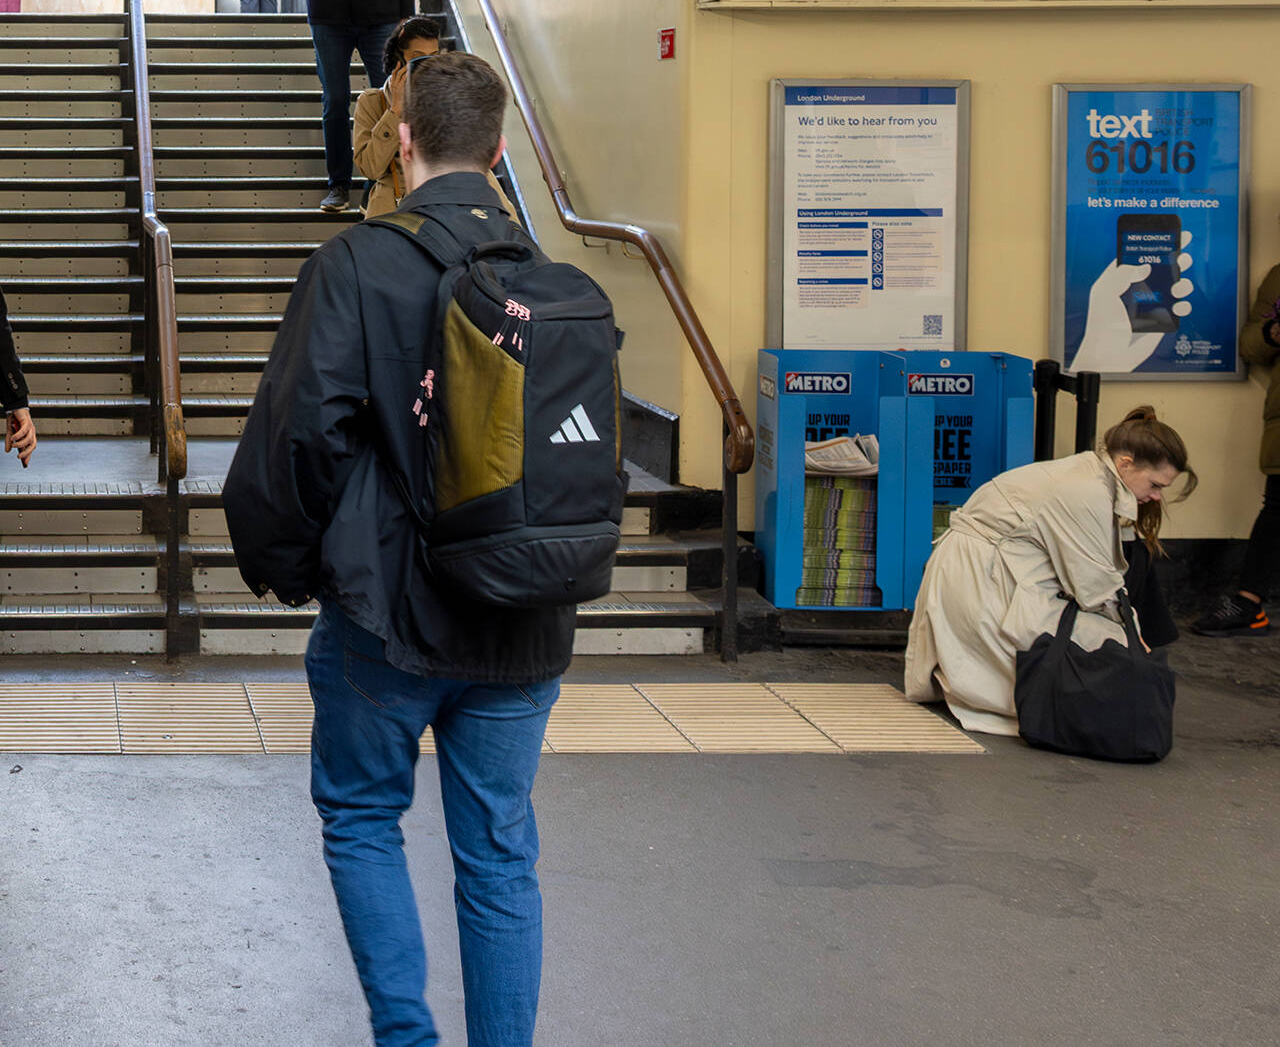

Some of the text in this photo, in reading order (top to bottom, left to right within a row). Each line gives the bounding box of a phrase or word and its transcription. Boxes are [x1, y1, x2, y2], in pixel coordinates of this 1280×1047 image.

[797, 94, 865, 103] London Underground
[798, 116, 937, 128] We'd like to hear from you
[1086, 109, 1153, 138] text
[1086, 140, 1196, 174] 61016
[1087, 197, 1219, 209] let's make a difference
[1138, 255, 1161, 263] 61016
[788, 376, 848, 392] METRO
[911, 377, 970, 393] METRO
[808, 414, 850, 426] UP YOUR
[947, 415, 973, 427] YOUR
